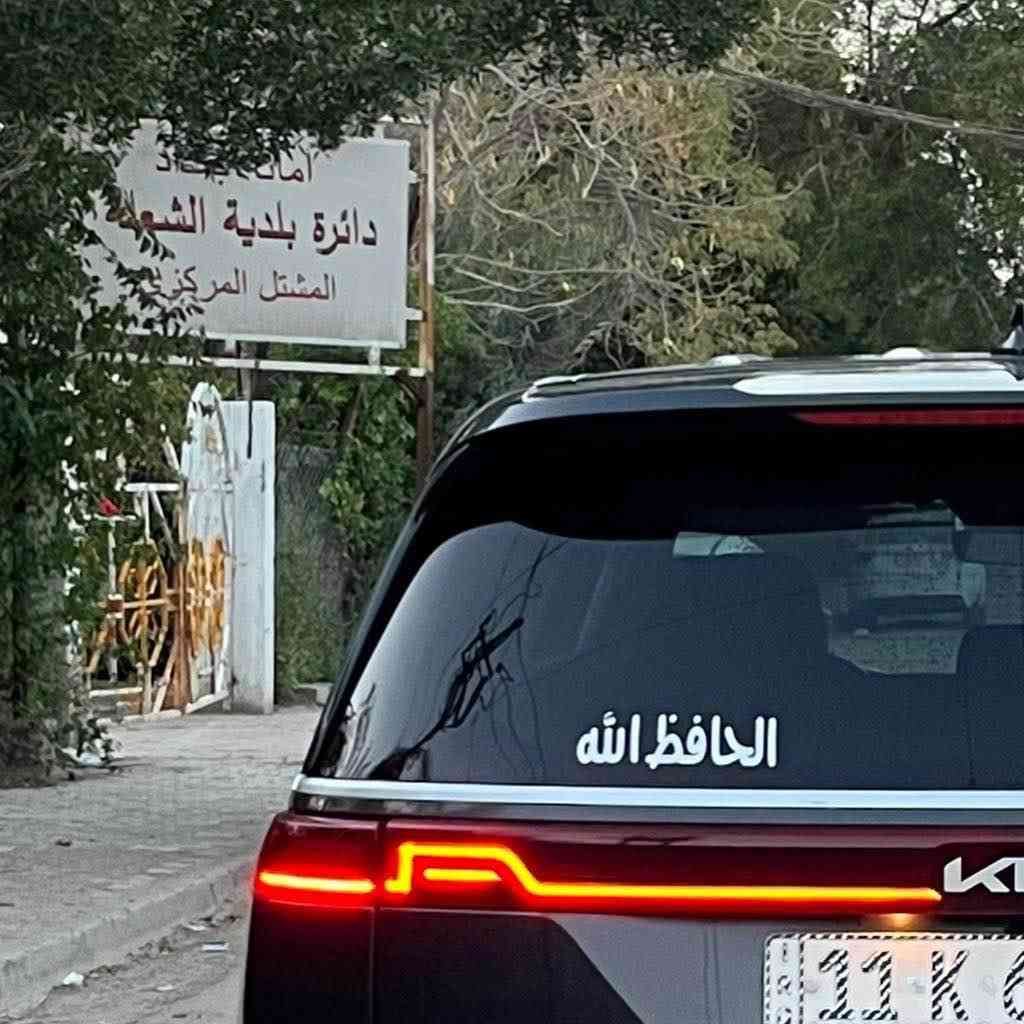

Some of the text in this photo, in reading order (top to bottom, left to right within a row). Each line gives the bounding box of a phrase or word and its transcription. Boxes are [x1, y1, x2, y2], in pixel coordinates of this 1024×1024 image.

[223, 198, 296, 250] بلدية
[312, 205, 377, 255] دائرة
[259, 269, 336, 302] المشتل
[644, 713, 778, 770] الحافظ
[817, 947, 899, 1022] 11
[930, 948, 970, 1022] K
